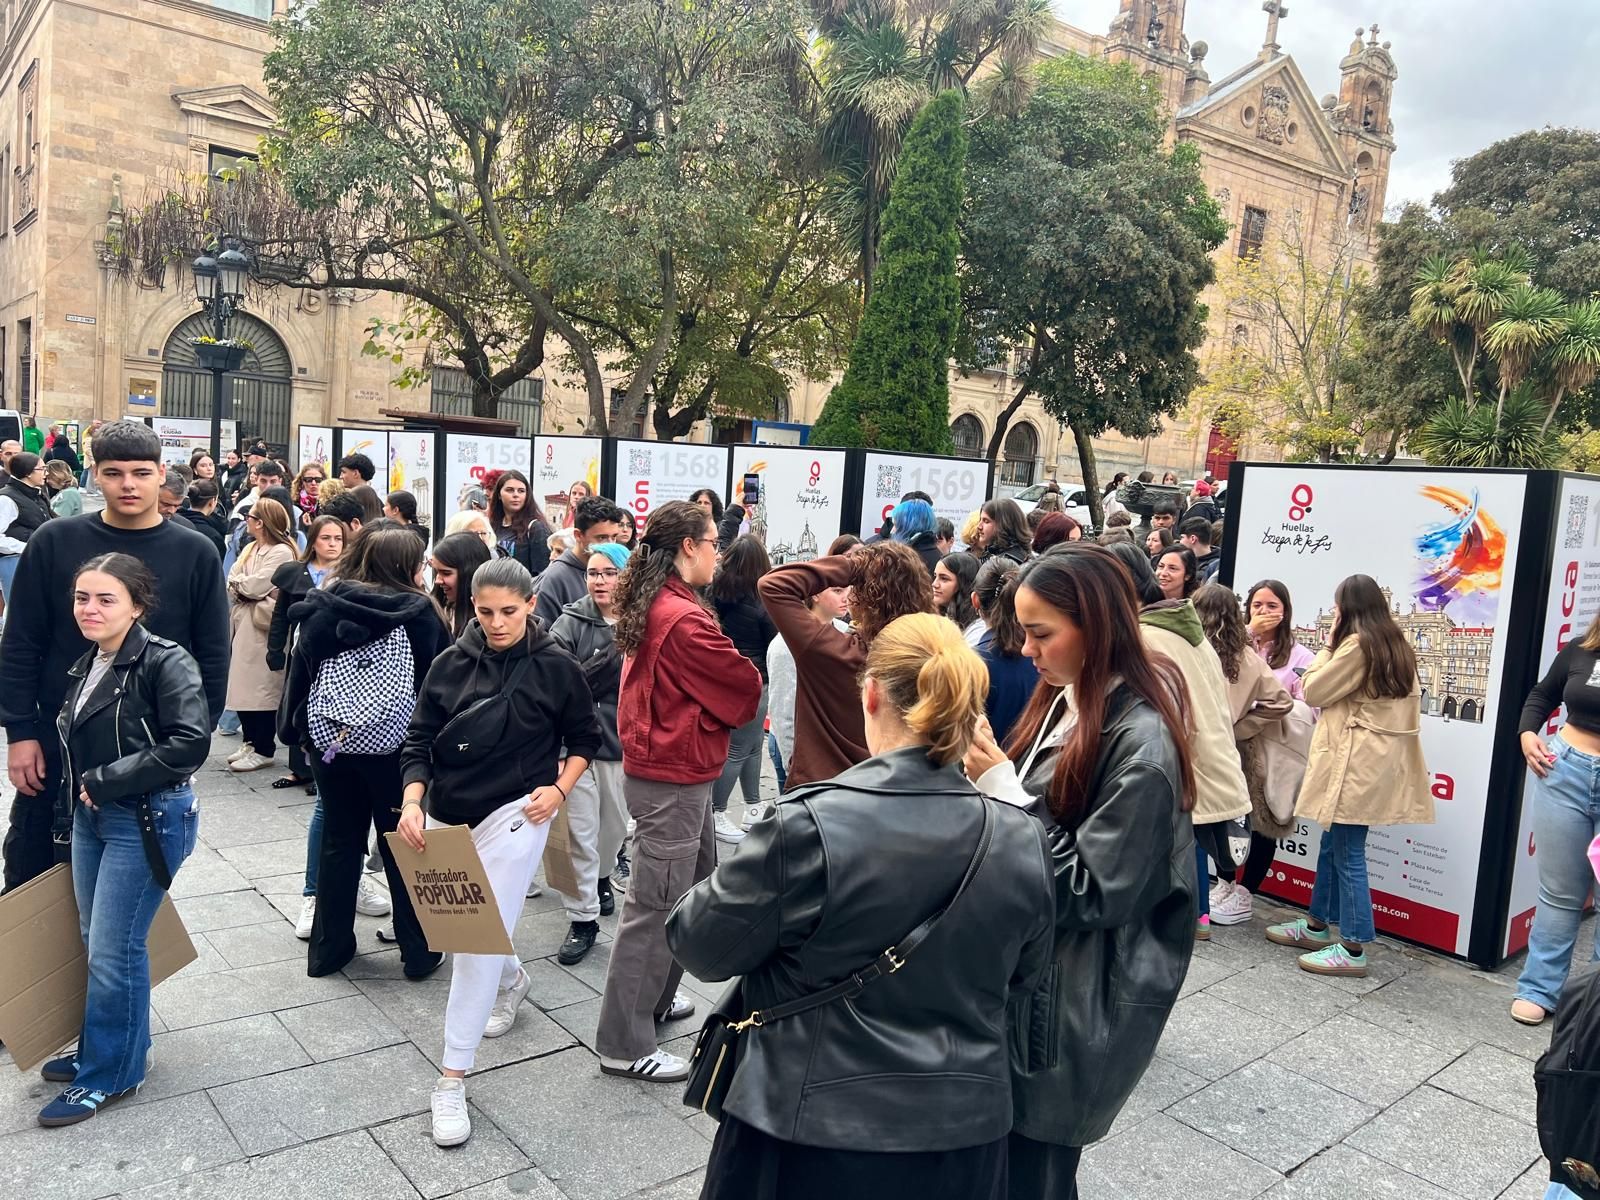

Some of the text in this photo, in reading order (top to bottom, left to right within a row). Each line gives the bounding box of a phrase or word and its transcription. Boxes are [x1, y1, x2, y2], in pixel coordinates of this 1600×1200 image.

[485, 443, 530, 465] 156
[659, 452, 719, 479] 1568
[910, 467, 975, 501] 1569
[1281, 522, 1314, 533] Huellas
[1372, 843, 1399, 856] Salamanca
[1413, 840, 1439, 852] Convento
[1412, 847, 1446, 860] San Esteban
[1410, 861, 1444, 875] Plaza Mayor
[414, 867, 469, 886] Panificadora
[1368, 871, 1385, 881] terrey
[1409, 875, 1422, 883] Casa
[413, 882, 487, 905] POPULAR
[1408, 882, 1444, 897] Santa Teresa
[1292, 877, 1410, 920] www esa.com
